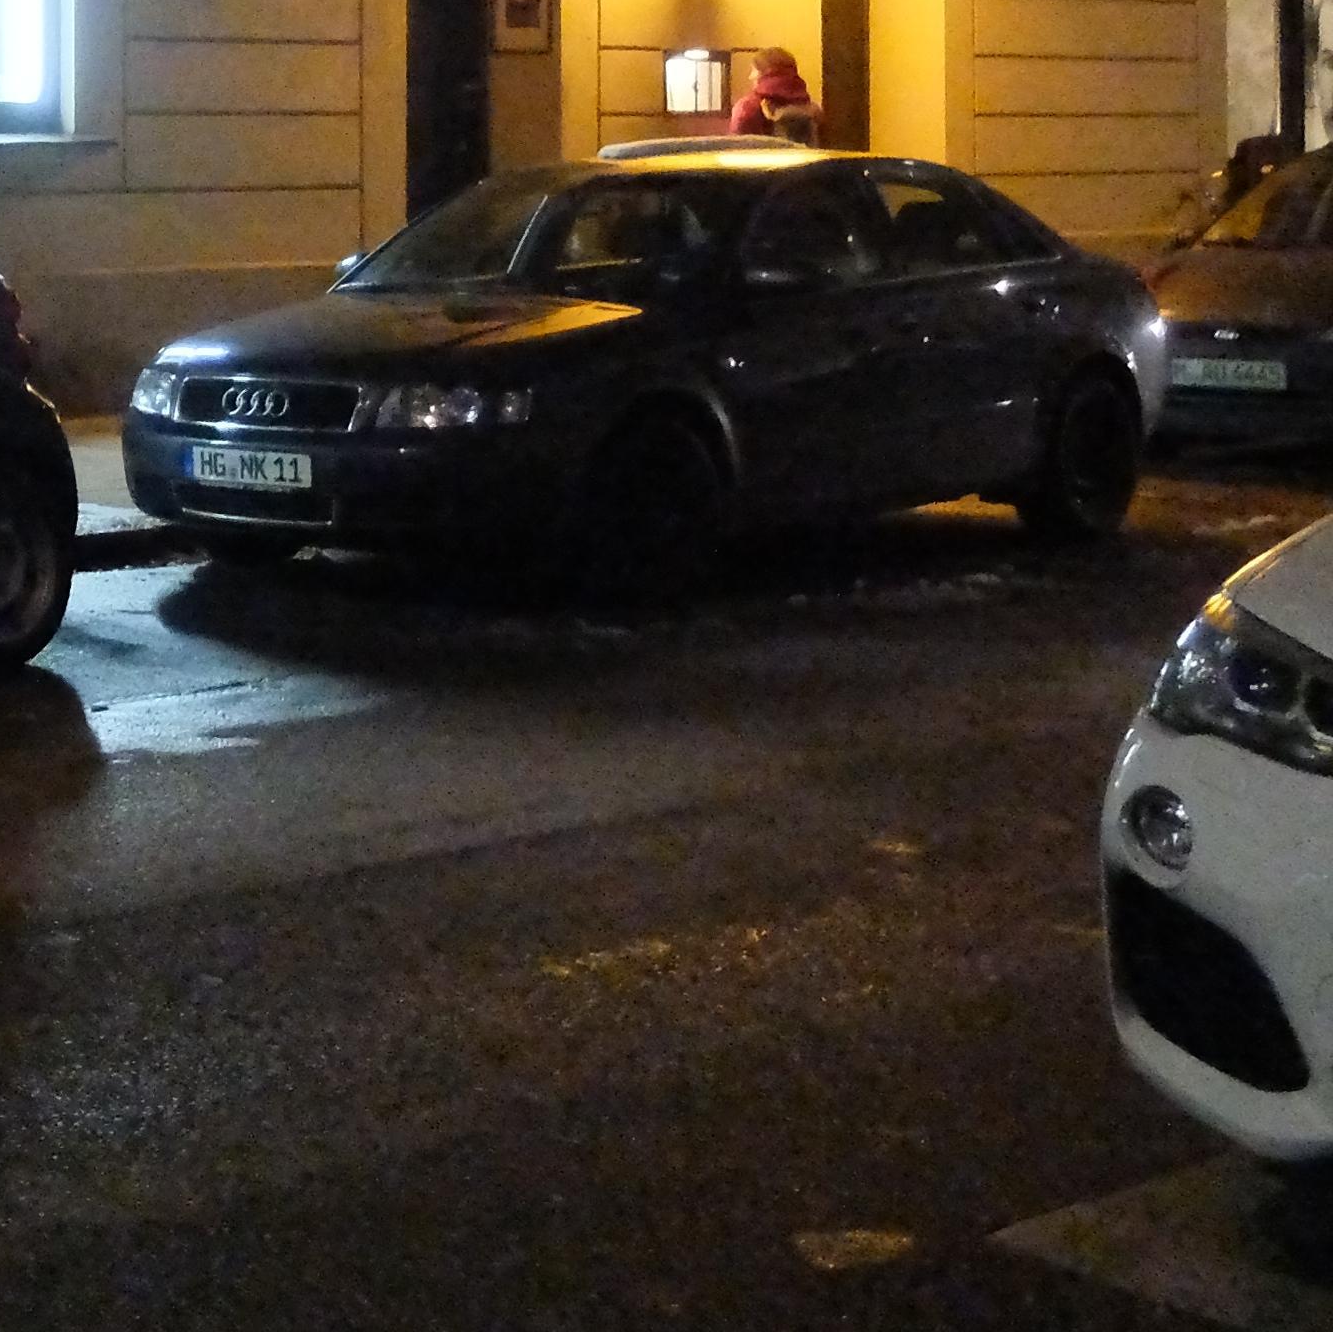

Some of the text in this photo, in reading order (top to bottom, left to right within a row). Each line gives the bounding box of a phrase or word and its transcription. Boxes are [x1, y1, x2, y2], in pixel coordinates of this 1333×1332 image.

[200, 450, 303, 483] HG NK 11
